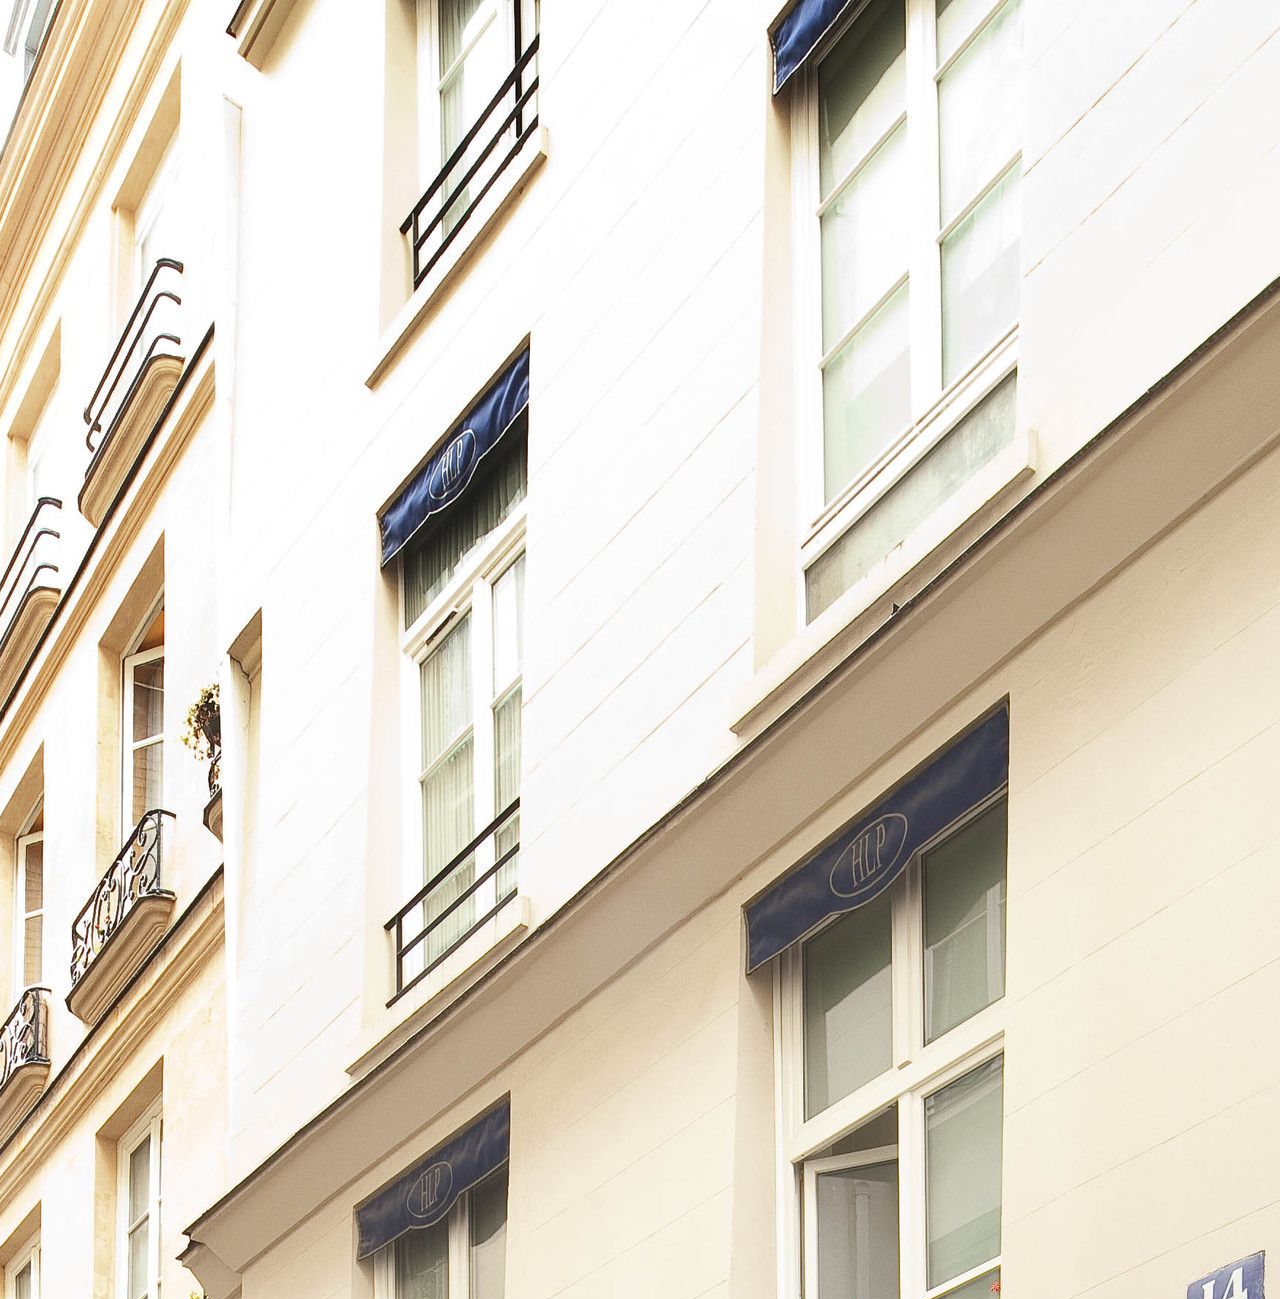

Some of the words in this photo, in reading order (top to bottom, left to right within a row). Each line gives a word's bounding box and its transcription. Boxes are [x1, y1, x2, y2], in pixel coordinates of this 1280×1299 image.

[441, 438, 463, 491] HLP
[851, 822, 886, 888] HLP
[420, 1167, 441, 1212] HLP
